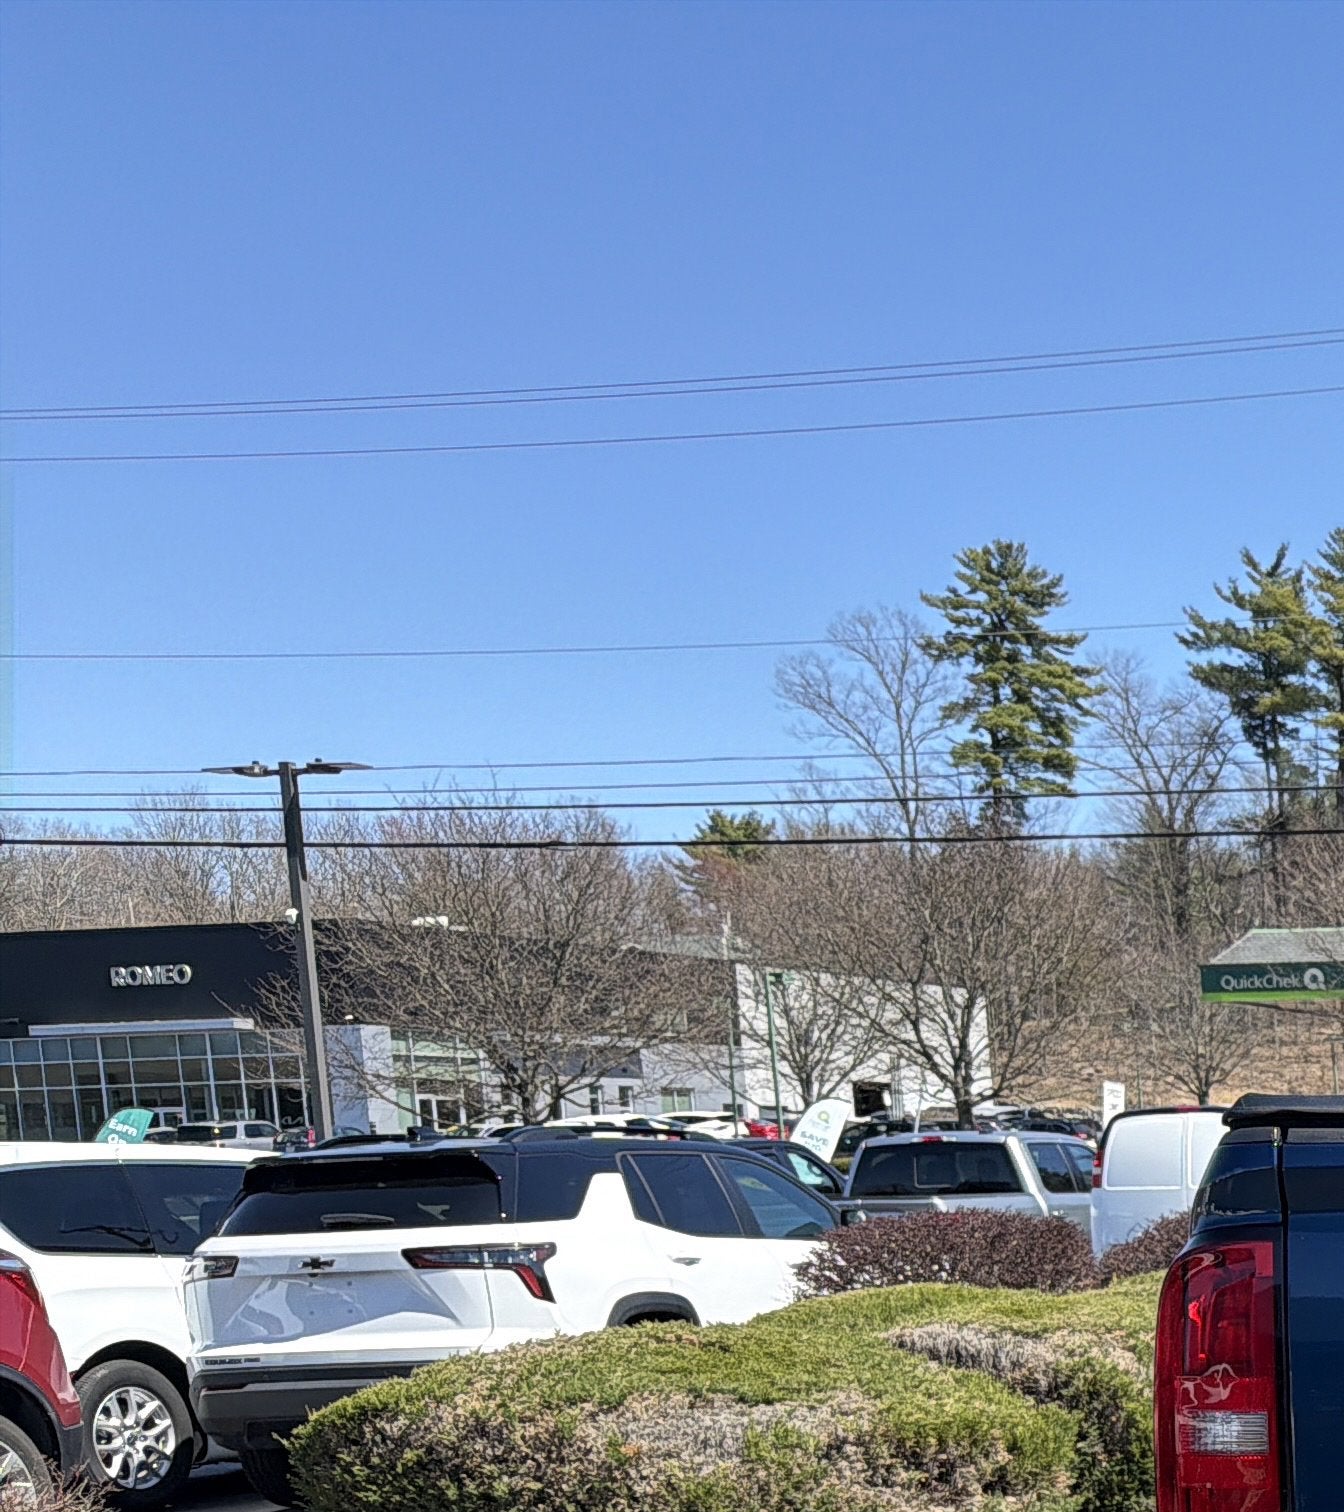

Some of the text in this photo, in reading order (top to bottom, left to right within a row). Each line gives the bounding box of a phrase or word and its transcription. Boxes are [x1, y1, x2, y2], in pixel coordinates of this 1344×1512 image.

[109, 963, 192, 988] ROMEO
[1220, 974, 1302, 992] QuickChek
[108, 1118, 138, 1137] Earn
